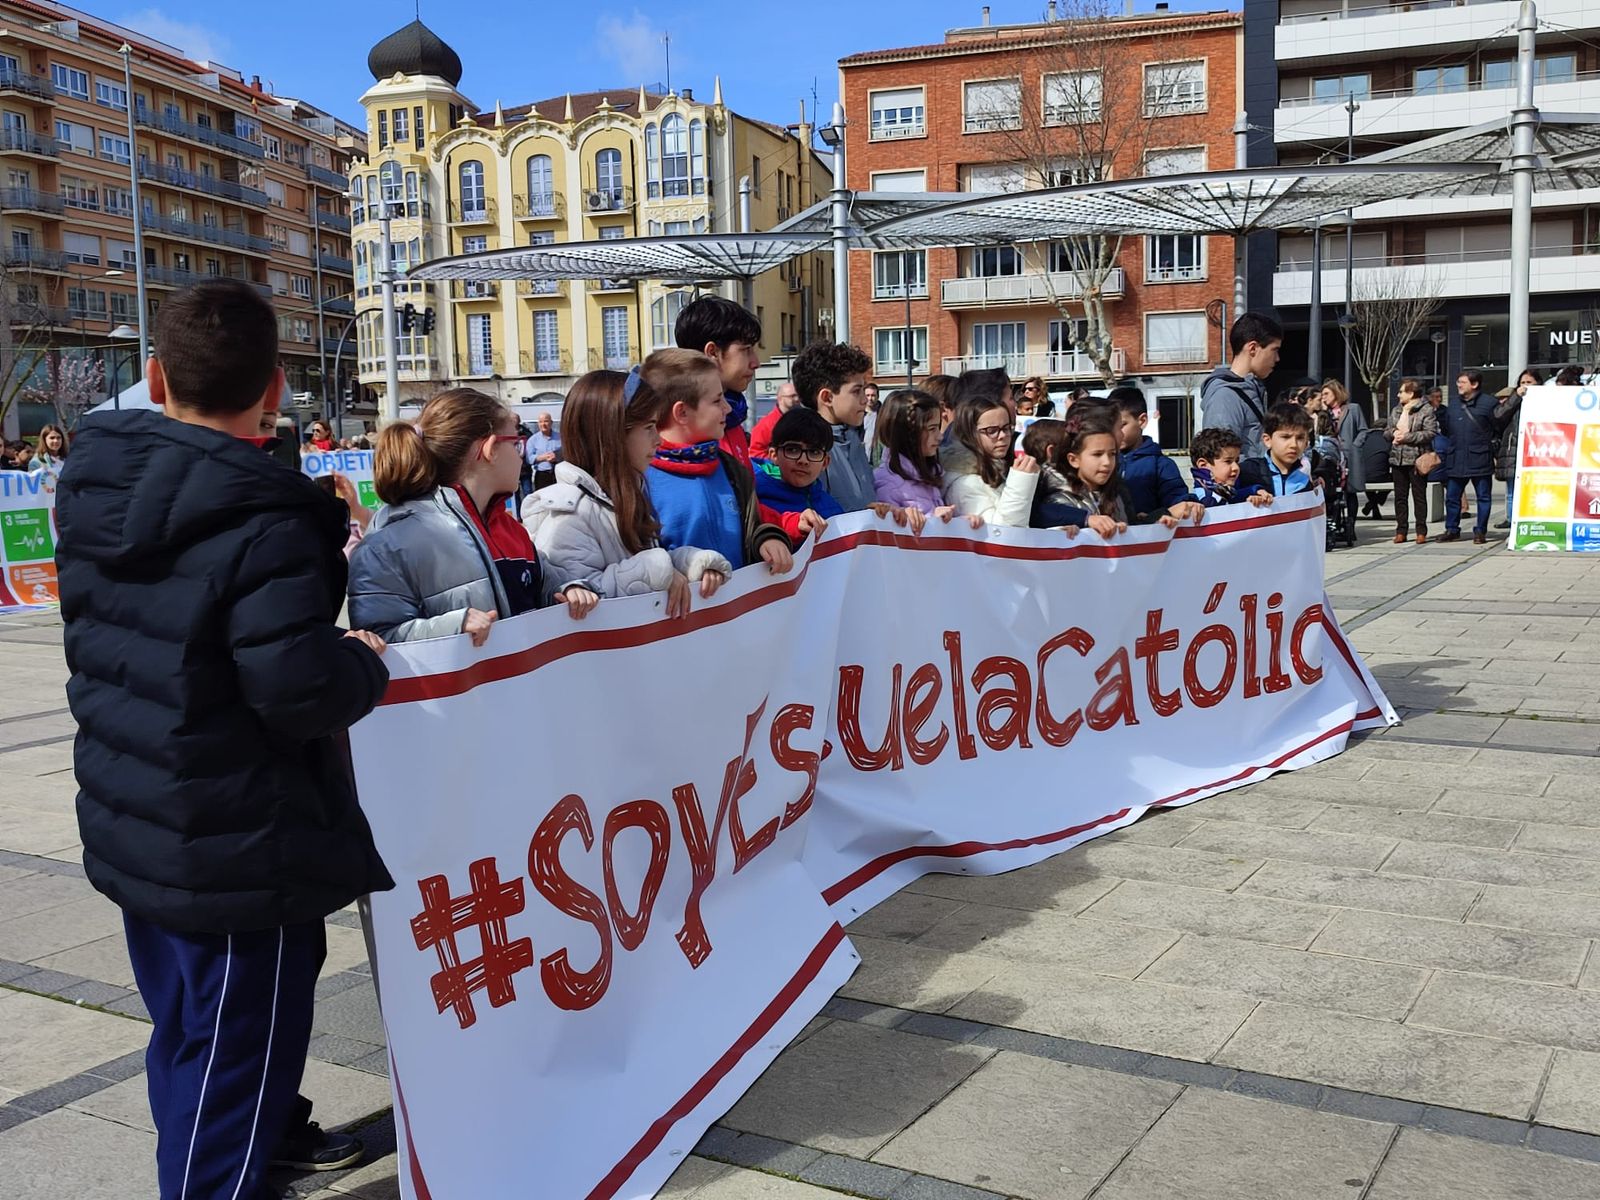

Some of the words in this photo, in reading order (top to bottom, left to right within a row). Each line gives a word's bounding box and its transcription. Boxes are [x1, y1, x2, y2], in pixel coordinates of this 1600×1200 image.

[1550, 330, 1600, 345] NUE
[1519, 524, 1529, 536] 13
[1575, 526, 1586, 537] 14
